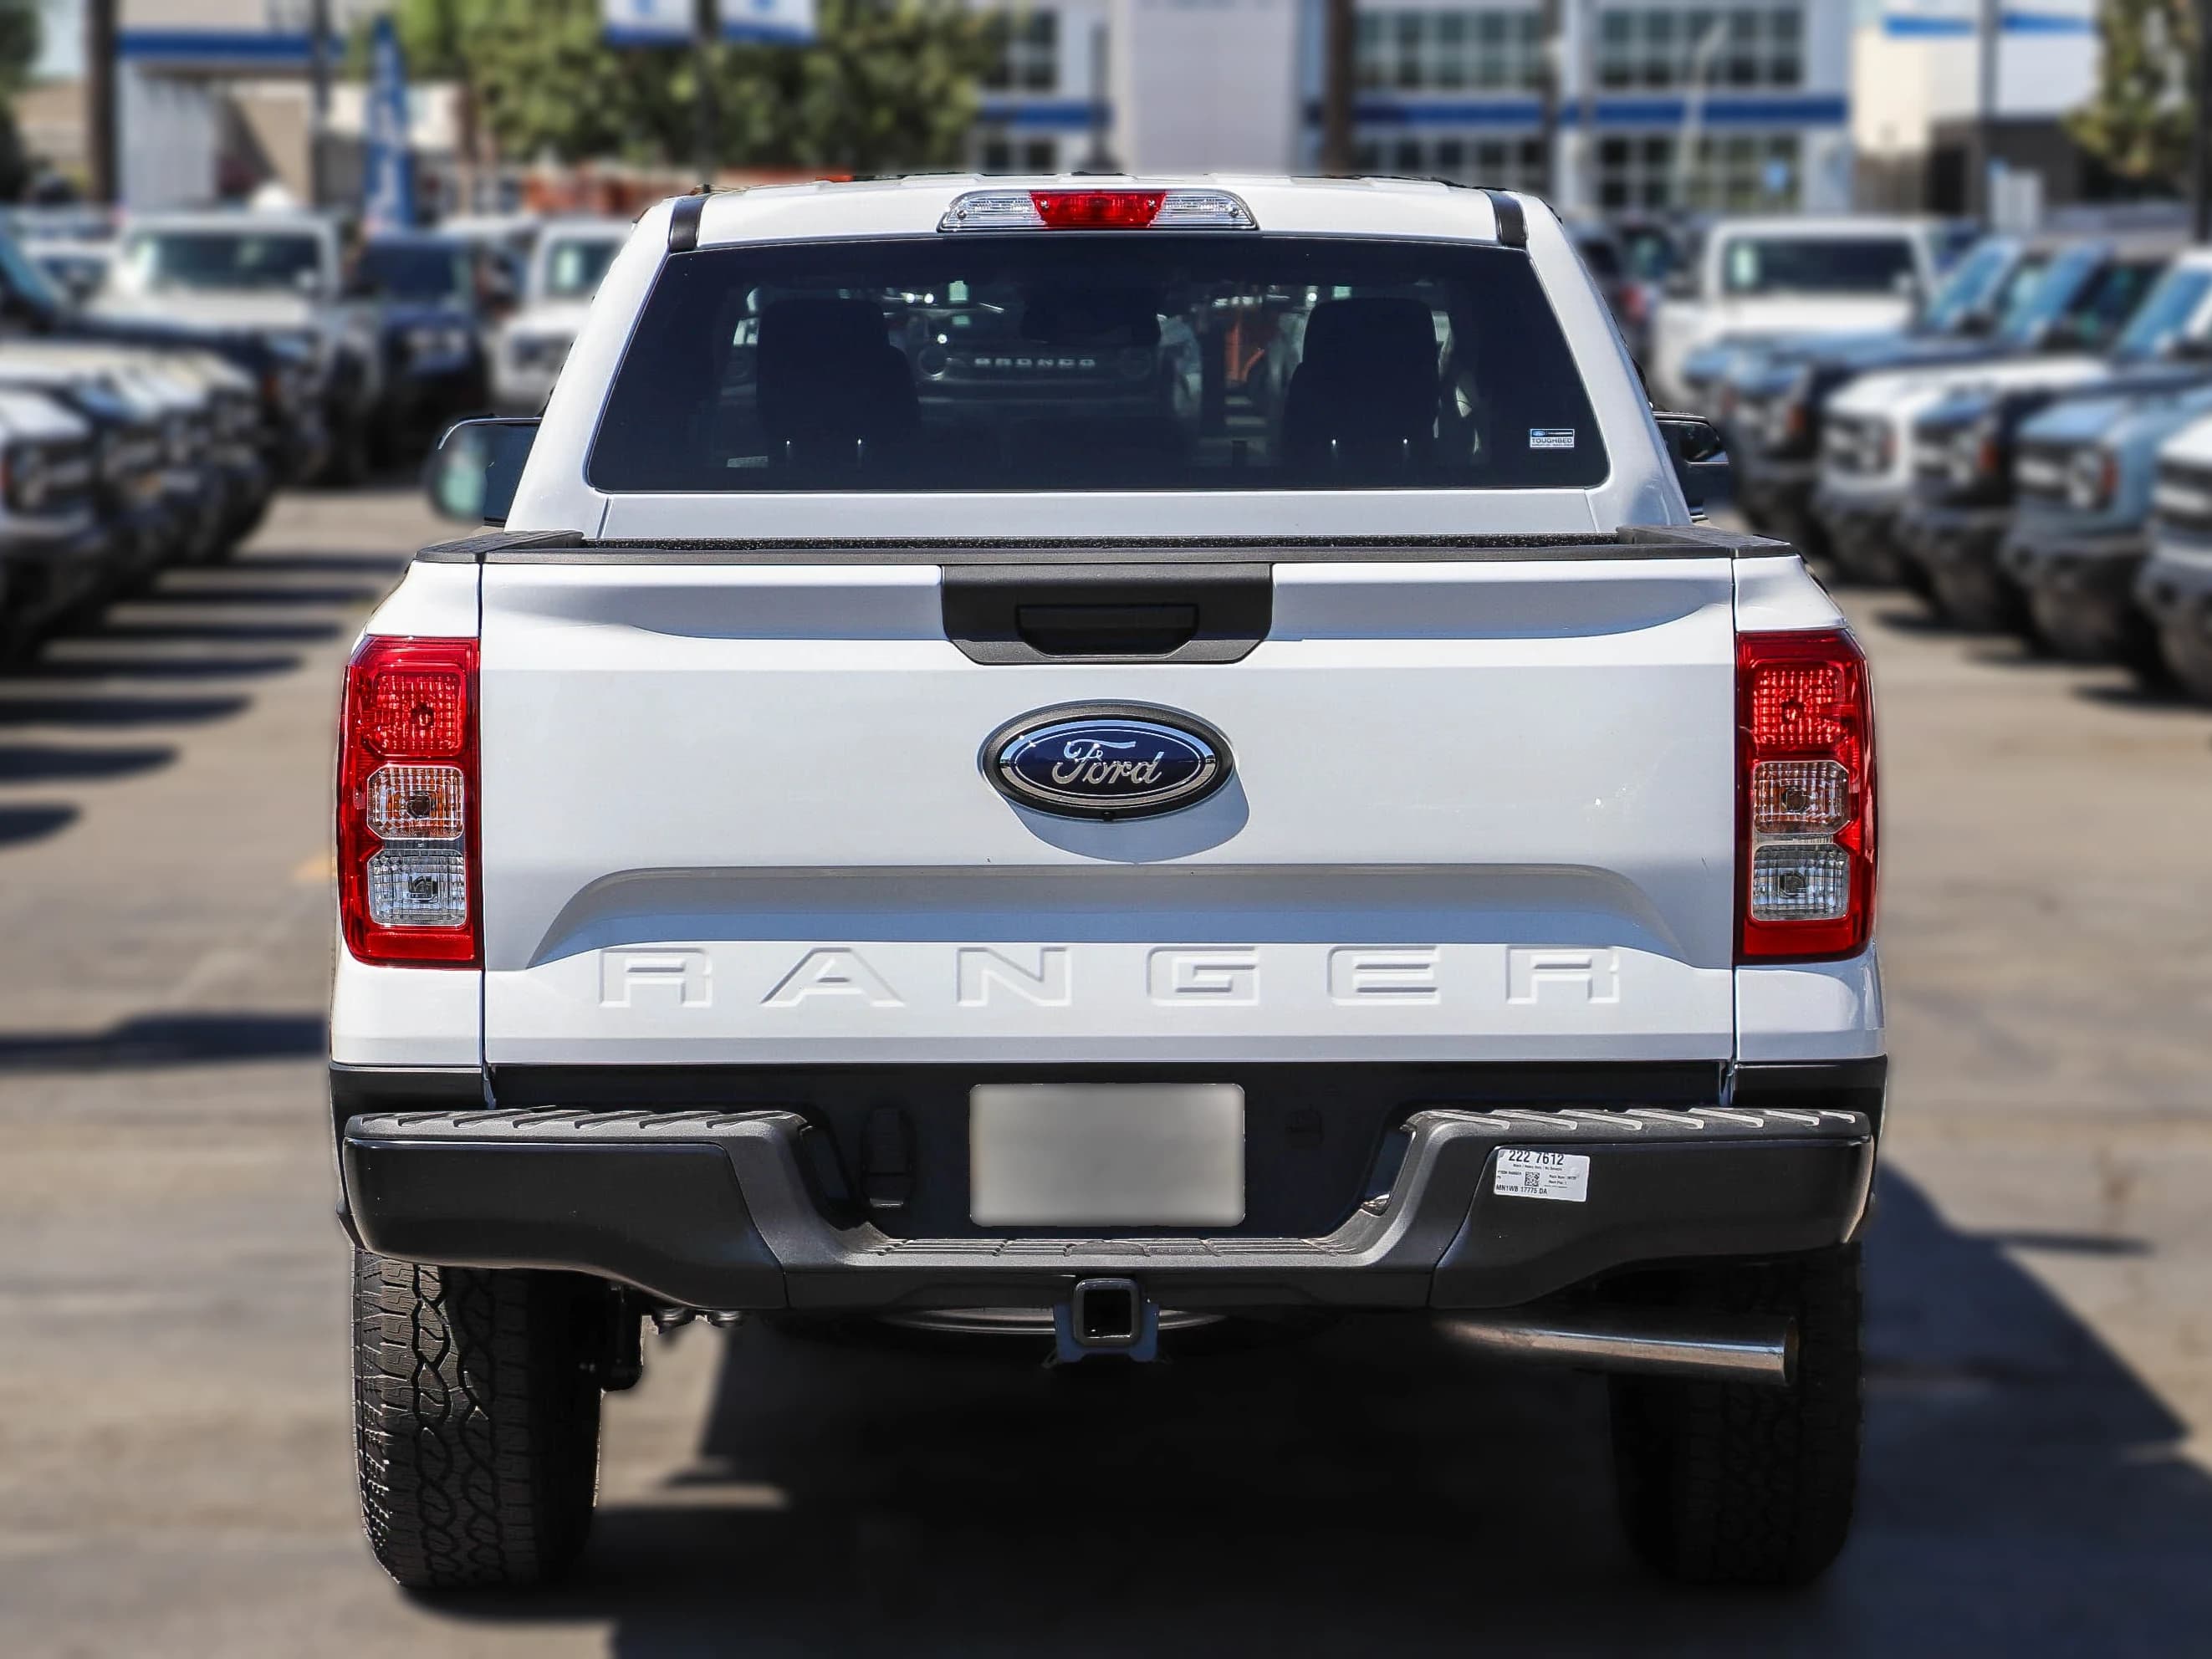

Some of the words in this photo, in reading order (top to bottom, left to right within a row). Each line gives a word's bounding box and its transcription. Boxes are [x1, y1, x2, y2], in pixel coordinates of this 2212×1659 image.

[974, 357, 1096, 367] BRONCO
[1051, 738, 1165, 784] Ford
[599, 946, 1621, 1008] RANGER
[1509, 1150, 1530, 1163] 222
[1536, 1152, 1565, 1166] 7612
